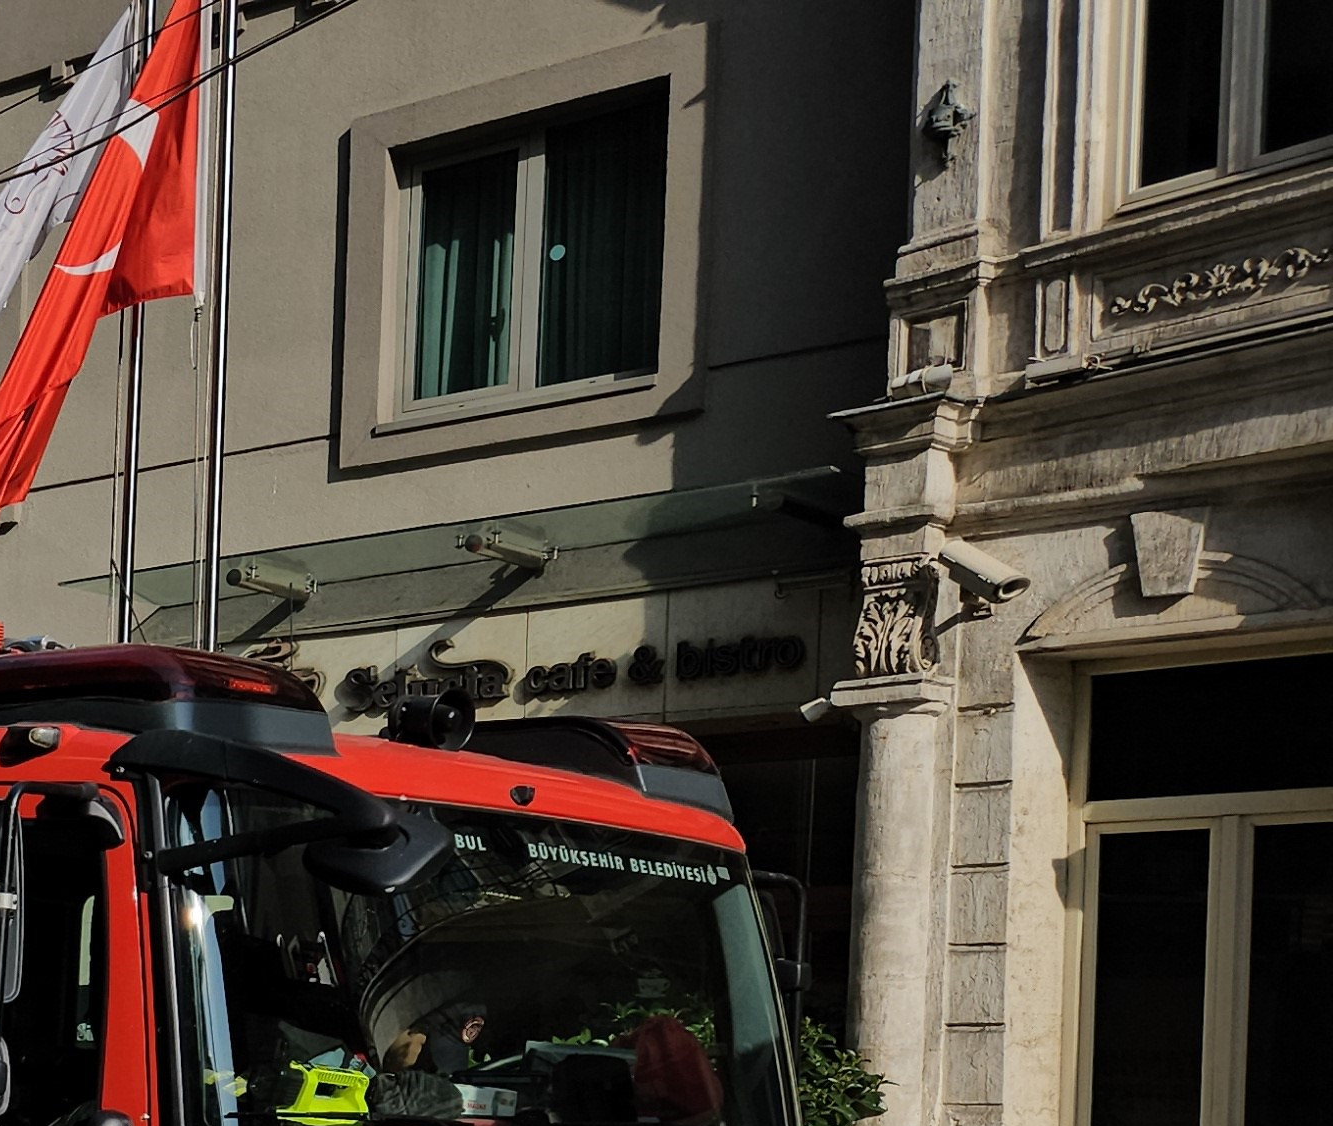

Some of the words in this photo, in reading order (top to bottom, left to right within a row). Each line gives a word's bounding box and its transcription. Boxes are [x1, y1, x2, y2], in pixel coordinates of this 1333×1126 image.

[524, 652, 617, 694] cafe
[633, 645, 663, 683] &
[675, 633, 806, 681] bistro
[527, 842, 625, 872] BÜYÜKŞEHİR
[629, 856, 707, 884] BELEDİYESİ
